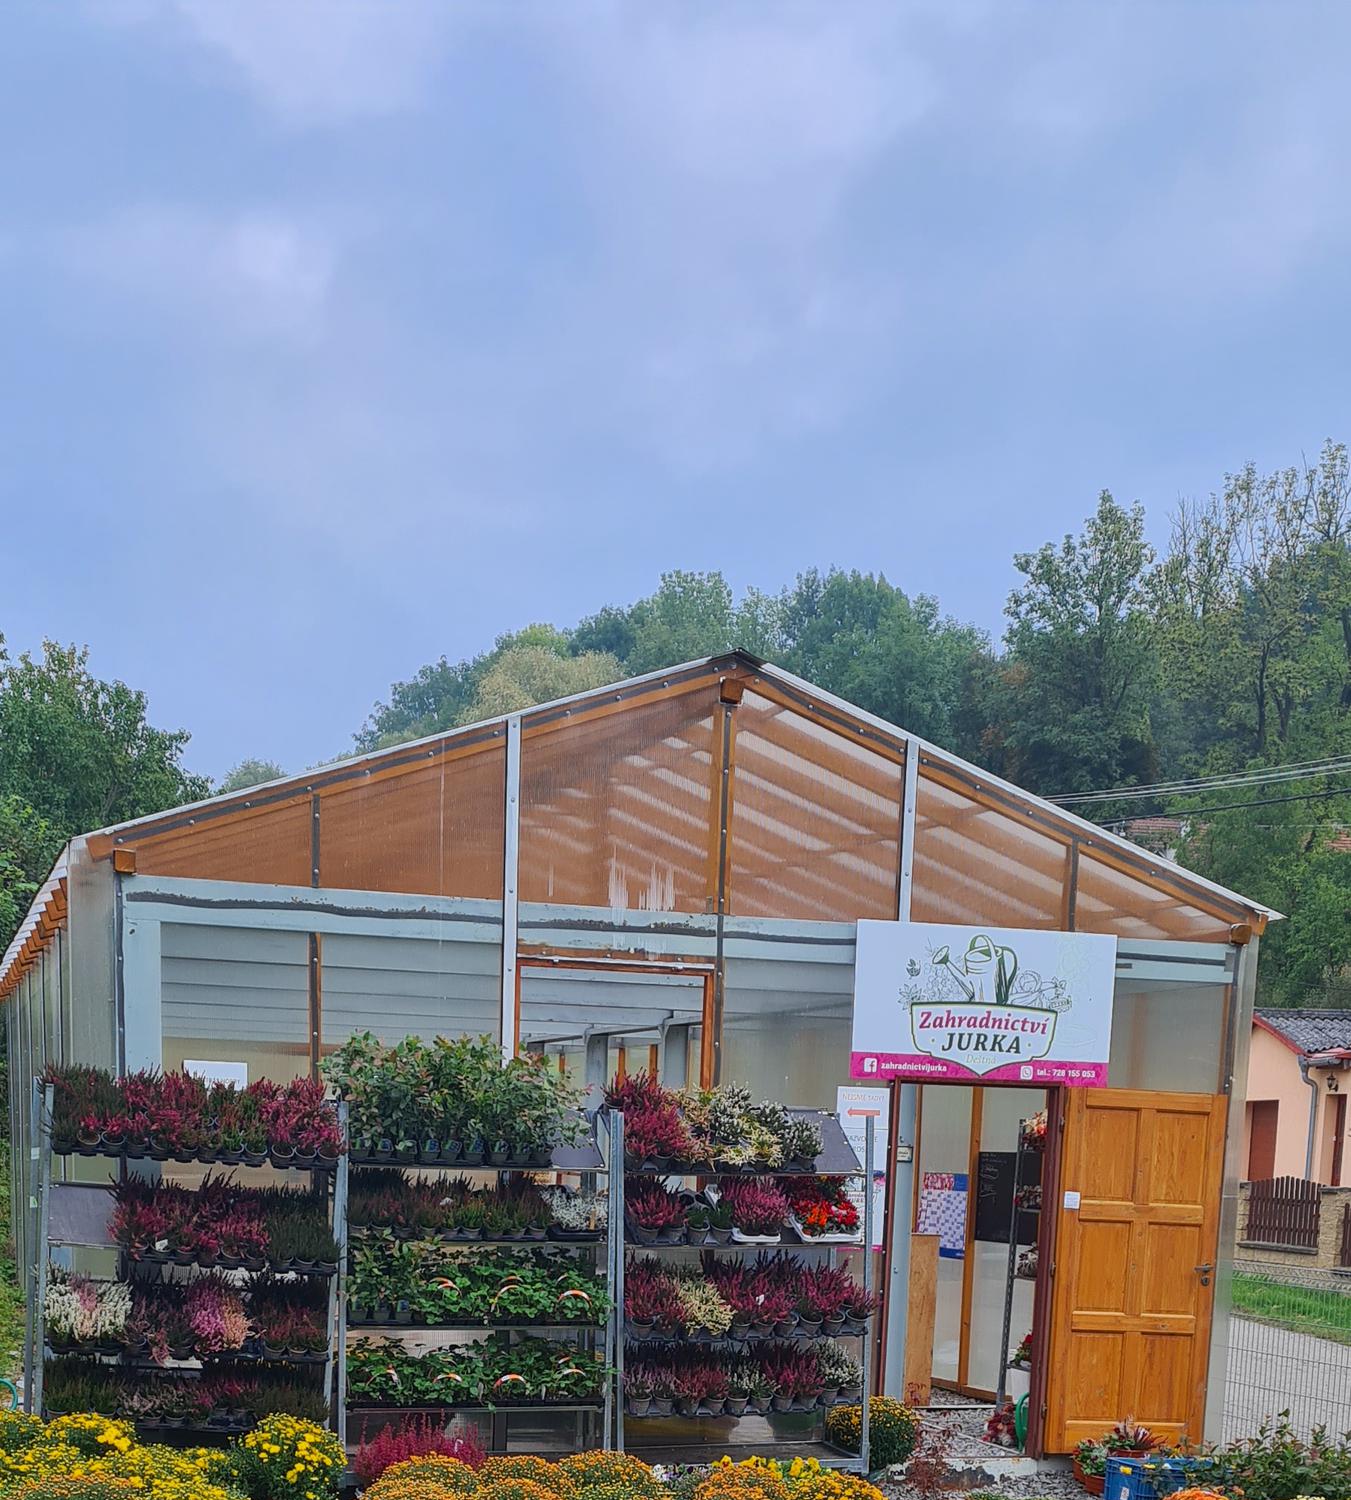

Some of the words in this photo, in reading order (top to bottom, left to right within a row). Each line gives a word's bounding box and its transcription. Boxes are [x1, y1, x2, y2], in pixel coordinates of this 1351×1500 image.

[919, 1010, 1050, 1035] Zahradnictví
[941, 1033, 1021, 1054] JURKA
[881, 1062, 947, 1073] zahradnictvijurka
[1037, 1068, 1051, 1076] tel.:
[1052, 1069, 1066, 1077] 728
[1068, 1070, 1080, 1078] 155
